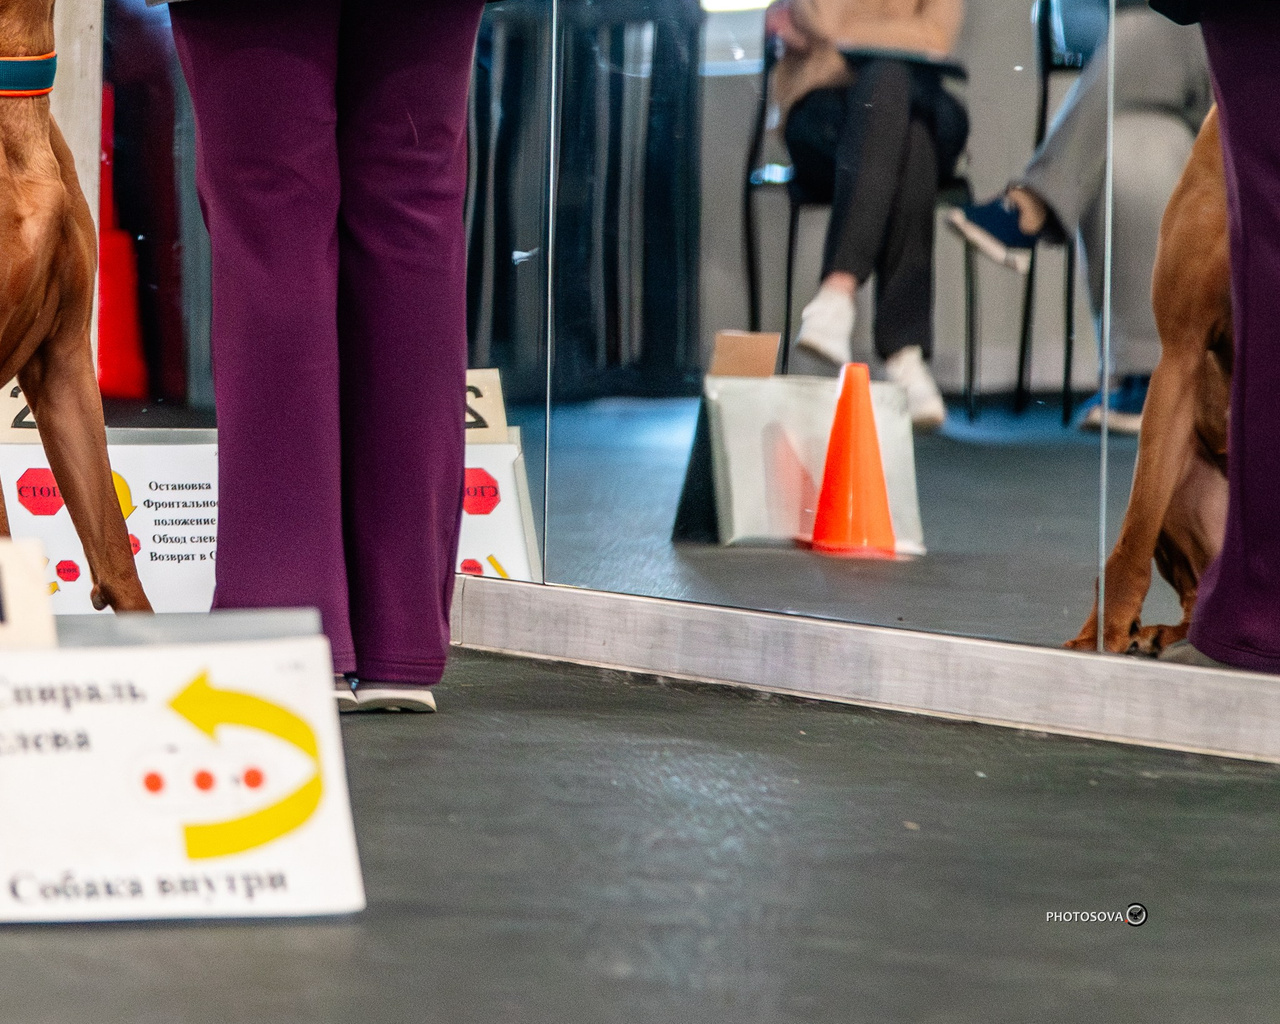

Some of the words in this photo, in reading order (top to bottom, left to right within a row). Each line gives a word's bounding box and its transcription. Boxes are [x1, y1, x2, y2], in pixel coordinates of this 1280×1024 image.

[10, 385, 38, 429] 2
[148, 480, 211, 491] Остановка
[154, 517, 216, 526] положение
[152, 533, 187, 544] Обход
[190, 535, 217, 543] слев
[150, 551, 195, 563] Возврат
[200, 553, 206, 561] в
[9, 870, 143, 903] Собака
[157, 871, 288, 903] внутри
